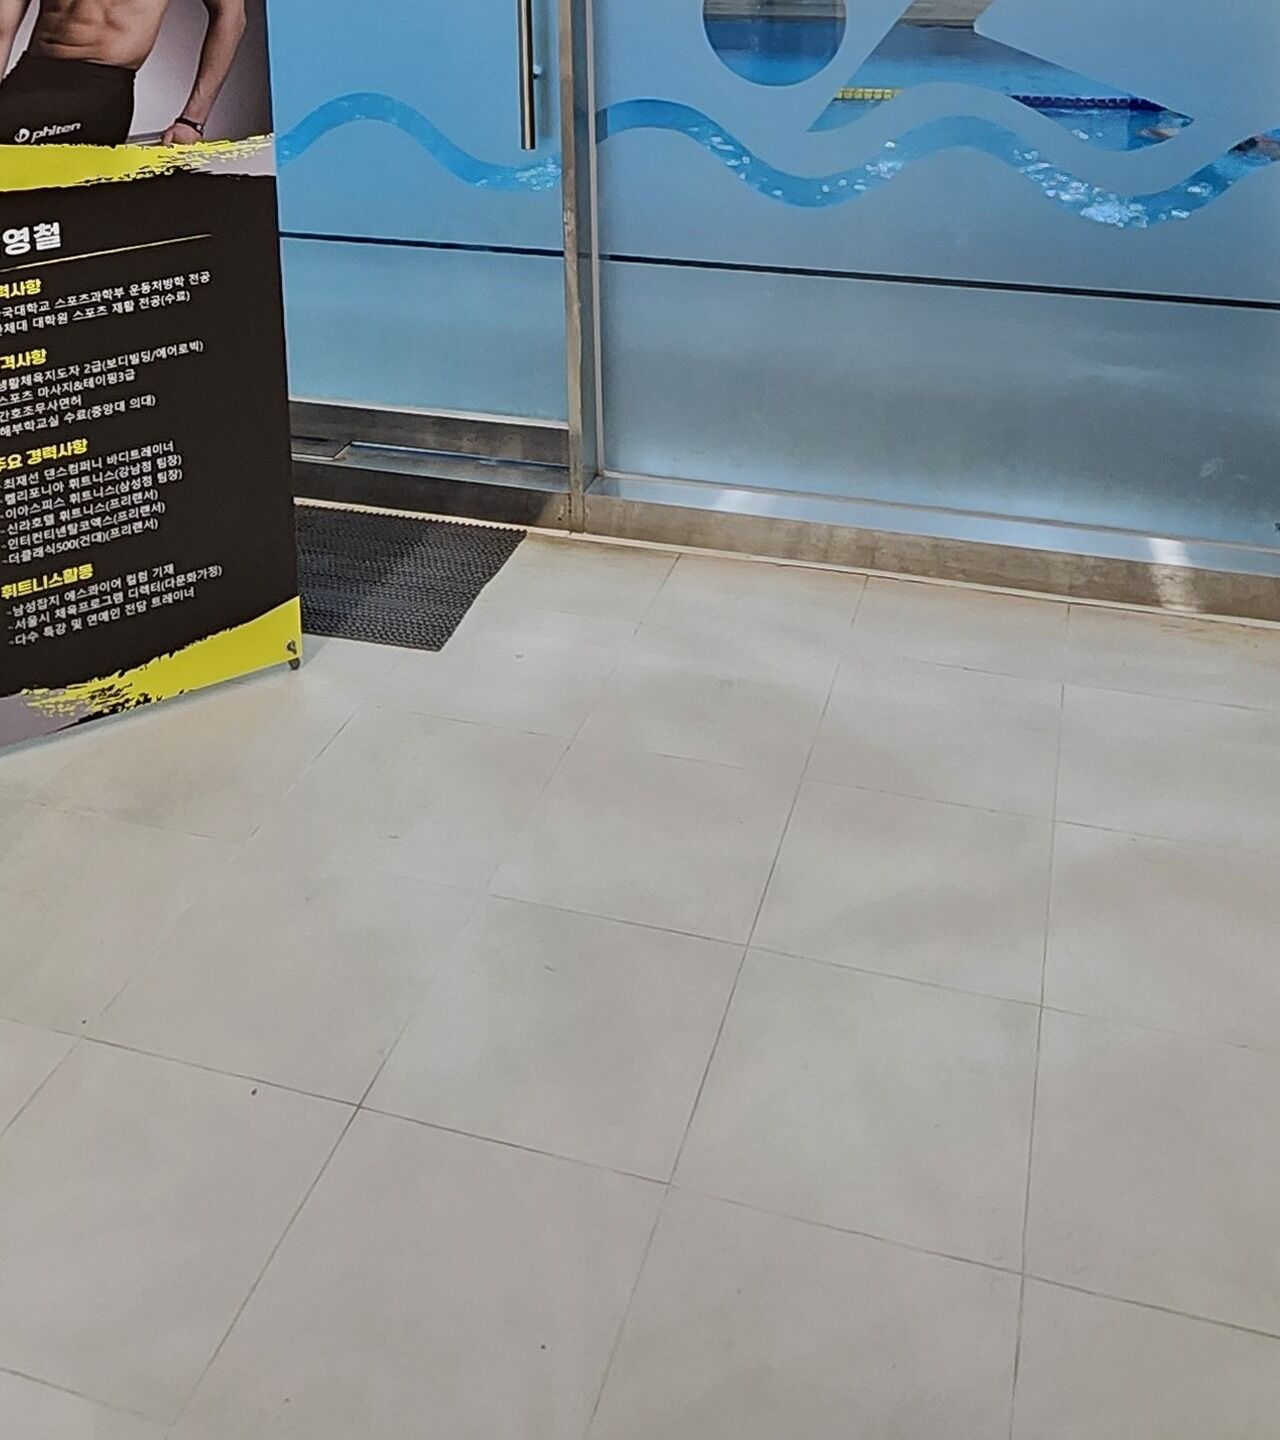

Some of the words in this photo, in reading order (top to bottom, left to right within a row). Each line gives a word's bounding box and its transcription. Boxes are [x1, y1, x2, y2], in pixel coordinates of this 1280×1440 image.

[30, 122, 82, 143] phiten
[53, 284, 125, 310] 스포츠과학부
[128, 275, 186, 297] 운동처방학
[188, 270, 211, 285] 전공
[32, 311, 69, 329] 대학원
[71, 305, 109, 322] 스포츠
[111, 301, 135, 315] 재활
[138, 290, 191, 309] 전공(수료)
[83, 339, 205, 375] 2급(보디빌딩/에어로빅)
[37, 368, 136, 398] 마사지&테이핑3급
[63, 401, 126, 425] 수료(중앙대
[129, 394, 156, 409] 의대)
[25, 438, 89, 466] 경력사항
[106, 440, 175, 466] 바디트레이너
[156, 454, 182, 469] 팀장)
[156, 468, 183, 484] 팀장)
[0, 562, 94, 600] 휘트니스활동
[54, 592, 124, 619] 체육프로그램
[127, 564, 223, 599] 디렉터(다문화가정)
[63, 577, 122, 602] 에스콰이어
[152, 562, 175, 578] 기재
[42, 621, 67, 638] 특강
[70, 617, 83, 632] 및
[86, 608, 121, 627] 연예인
[124, 600, 148, 616] 전담
[150, 586, 195, 608] 트레이너
